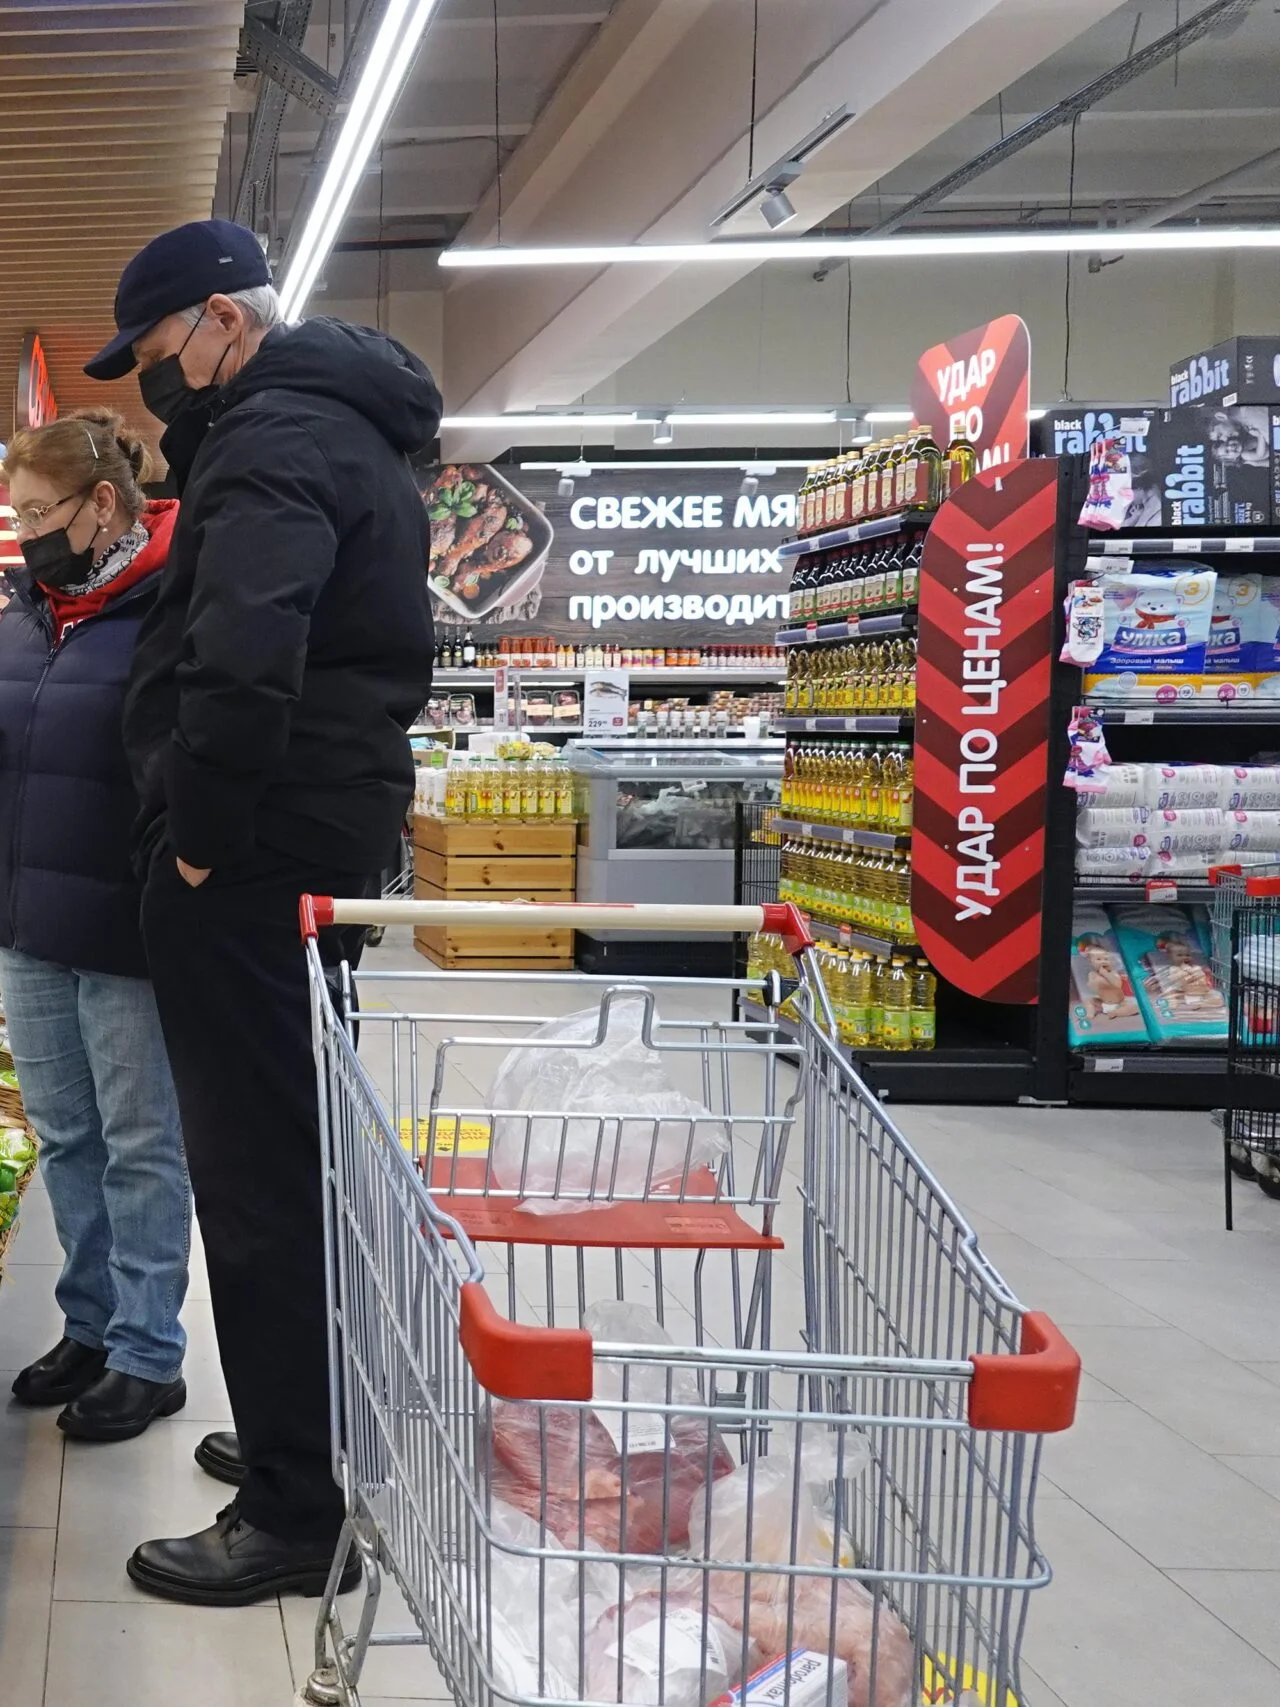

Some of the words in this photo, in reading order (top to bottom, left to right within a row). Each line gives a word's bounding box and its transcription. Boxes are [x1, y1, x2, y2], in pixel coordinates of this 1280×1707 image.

[937, 349, 996, 406] УДАР
[1171, 370, 1189, 386] black
[1171, 356, 1230, 408] rabbit
[949, 405, 983, 447] ПО
[1054, 419, 1081, 431] black
[1164, 444, 1205, 525] rabbit
[570, 495, 723, 529] СВЕЖЕЕ
[733, 493, 800, 528] МЯ
[1171, 501, 1182, 525] black
[569, 550, 614, 575] от
[634, 548, 783, 583] лучших
[1184, 581, 1200, 596] 3
[1237, 583, 1250, 597] 3
[960, 542, 1007, 715] ЦЕНАМ!
[1153, 656, 1185, 665] малыш
[959, 728, 999, 793] ПО
[955, 805, 1001, 921] УДАР
